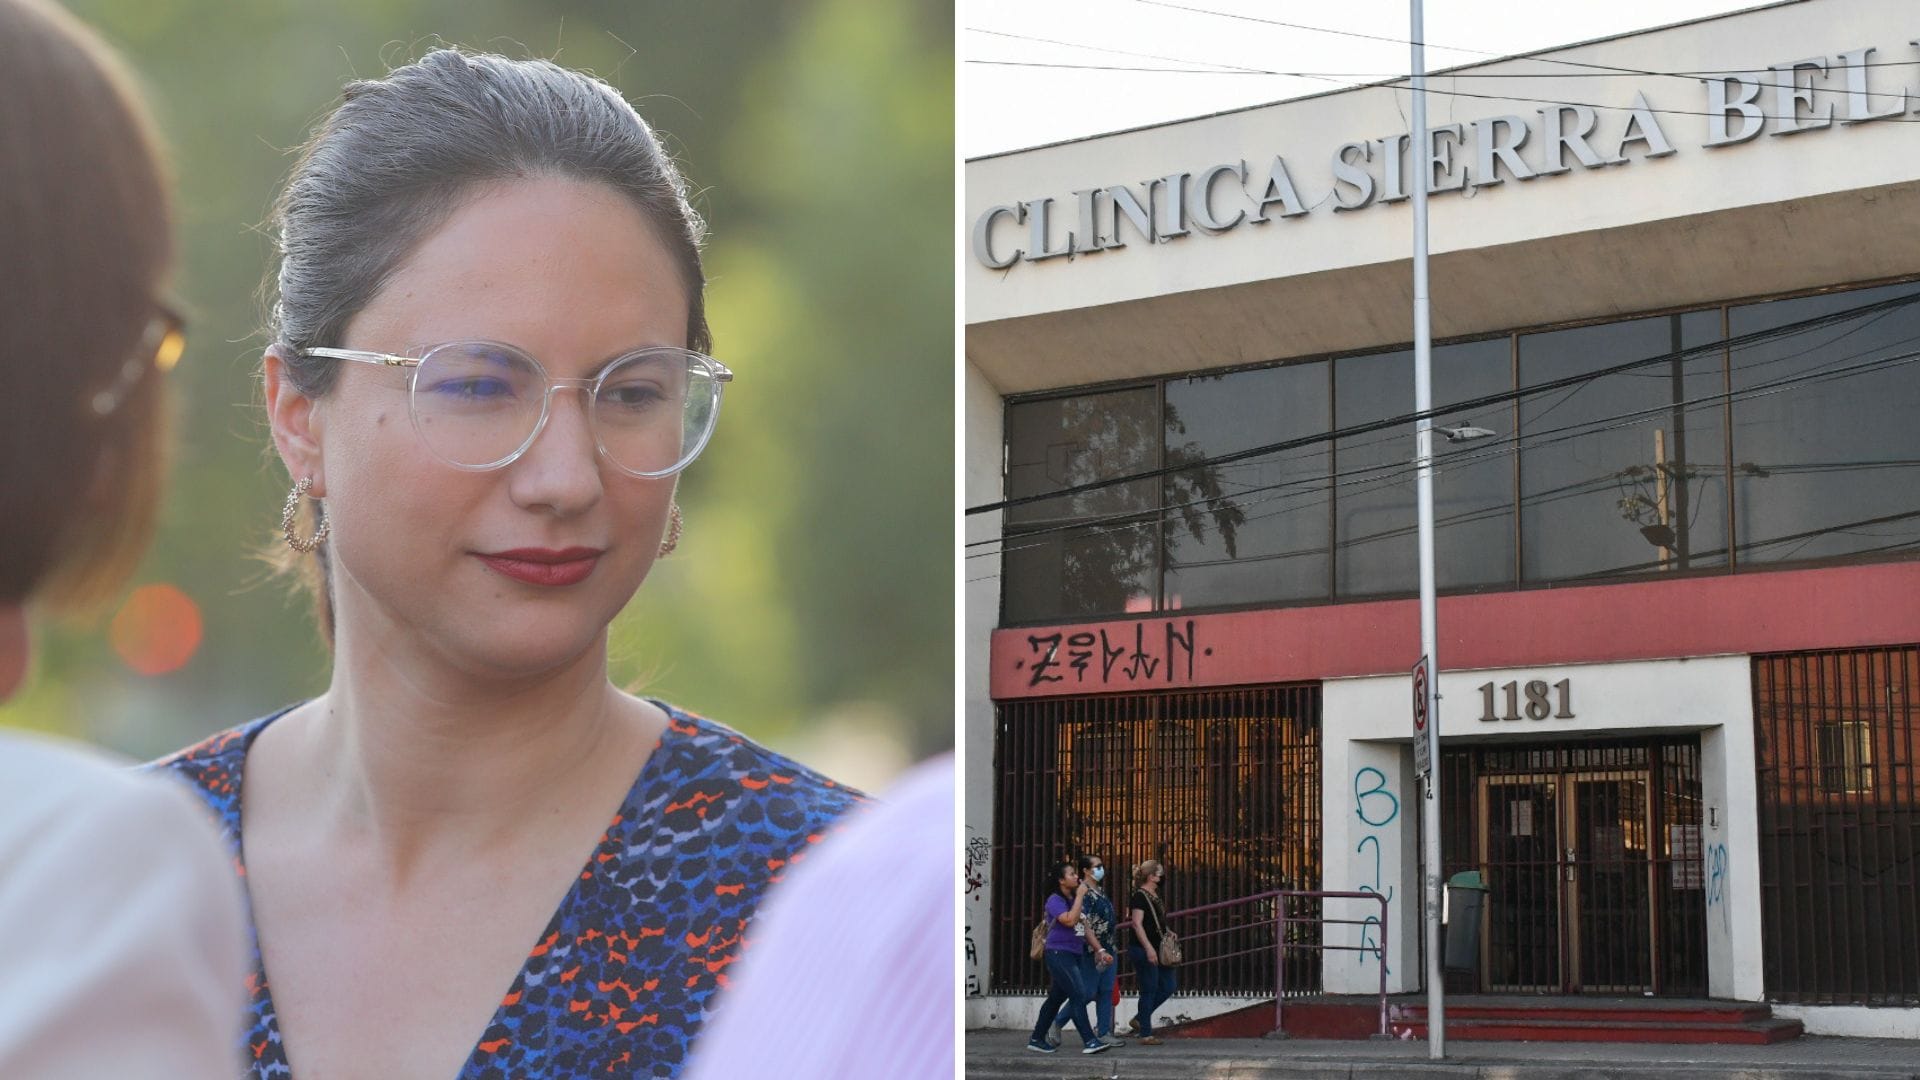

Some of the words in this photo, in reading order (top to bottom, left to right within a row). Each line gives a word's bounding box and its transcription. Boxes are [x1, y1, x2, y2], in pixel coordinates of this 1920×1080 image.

[973, 155, 1310, 270] CLINICA
[1332, 90, 1677, 213] SIERRA
[1478, 678, 1576, 721] 1181
